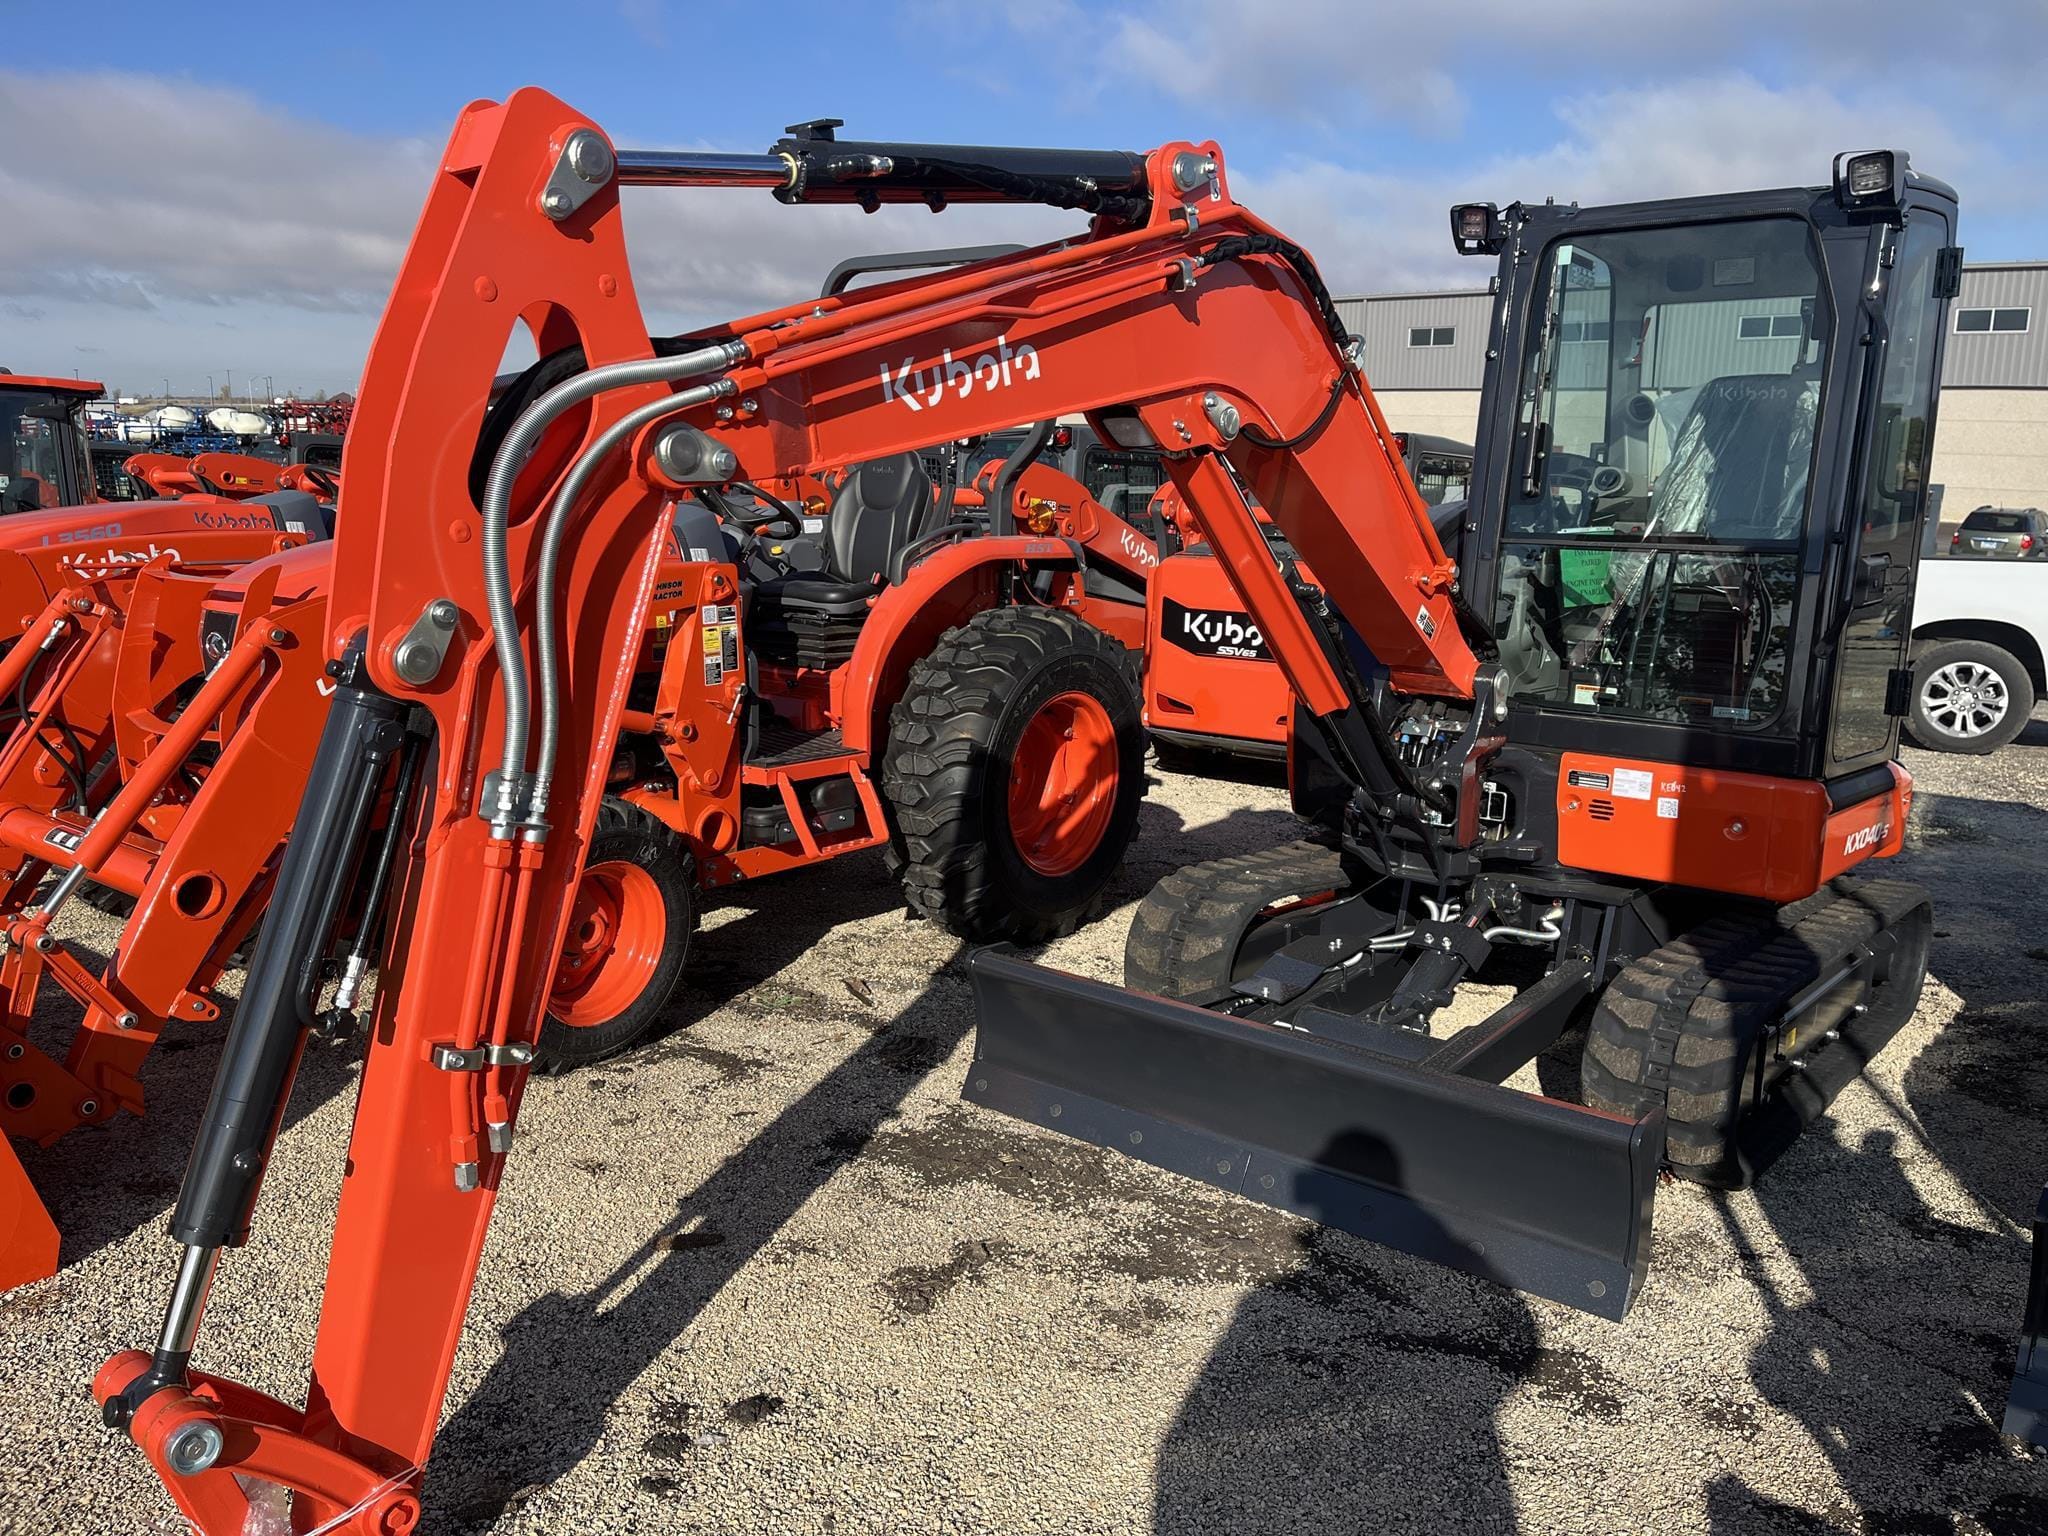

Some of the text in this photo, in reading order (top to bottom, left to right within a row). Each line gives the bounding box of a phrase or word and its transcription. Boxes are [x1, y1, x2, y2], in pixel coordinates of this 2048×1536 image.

[880, 335, 1041, 411] Kubota
[1720, 385, 1788, 400] Kubota
[193, 511, 272, 529] Kubota
[1120, 528, 1160, 567] Kubo
[1184, 612, 1264, 646] Kubo
[1216, 646, 1258, 657] SSV65
